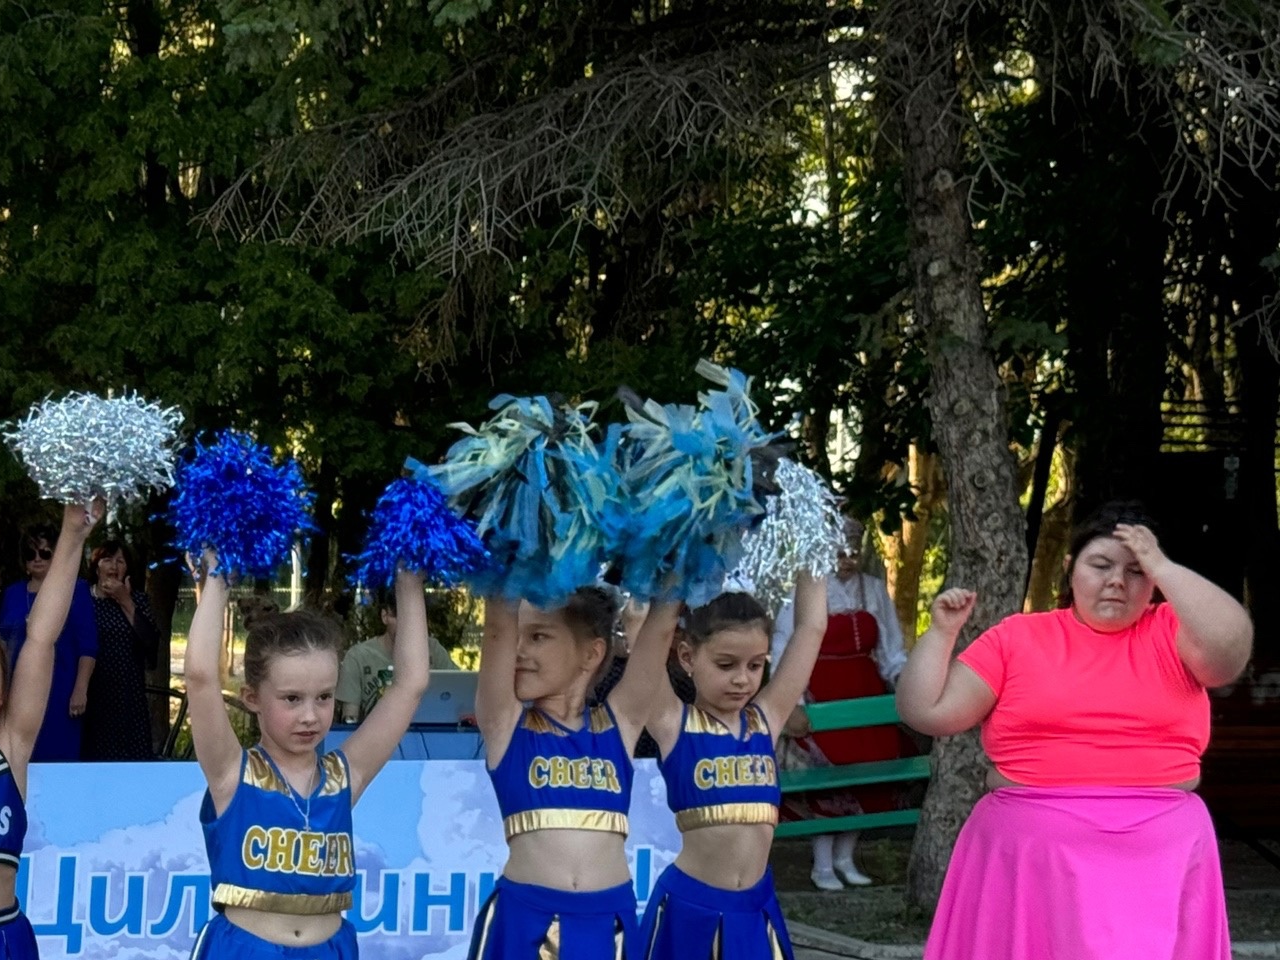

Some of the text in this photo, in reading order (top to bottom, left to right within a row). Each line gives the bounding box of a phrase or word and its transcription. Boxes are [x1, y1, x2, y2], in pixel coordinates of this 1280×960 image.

[528, 756, 621, 793] CHEER
[694, 755, 777, 790] CHEER
[242, 825, 353, 877] CHEER
